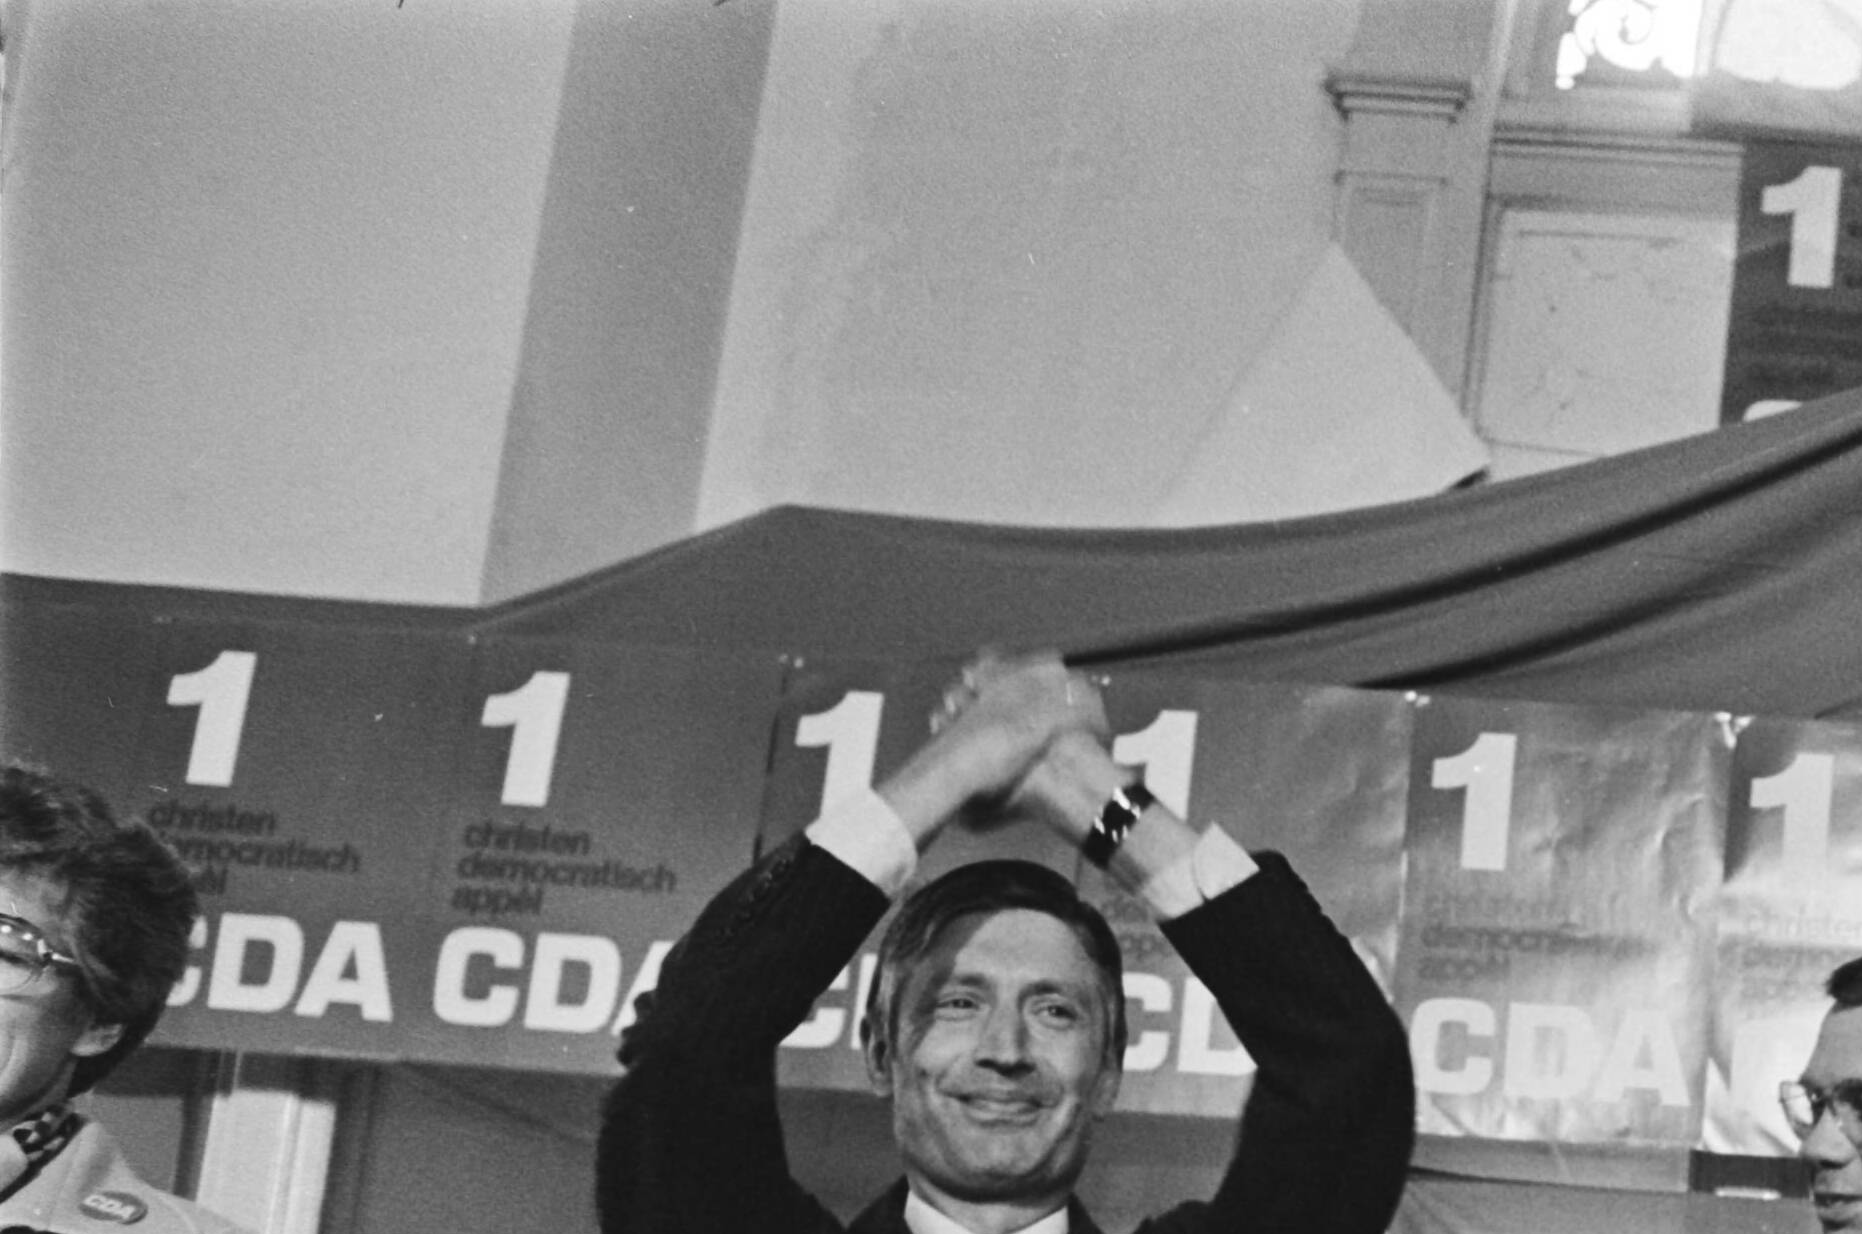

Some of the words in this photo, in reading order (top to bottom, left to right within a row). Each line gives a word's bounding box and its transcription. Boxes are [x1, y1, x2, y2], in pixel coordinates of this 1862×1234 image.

[1761, 166, 1842, 288] 1
[167, 651, 257, 787] 1
[481, 671, 570, 807] 1
[796, 690, 884, 828] 1
[1112, 710, 1198, 822] 1
[464, 820, 591, 857] christen
[1431, 732, 1517, 871] 1
[1750, 753, 1834, 888] 1
[457, 851, 678, 893] democratisch
[1409, 997, 1691, 1107] CDA
